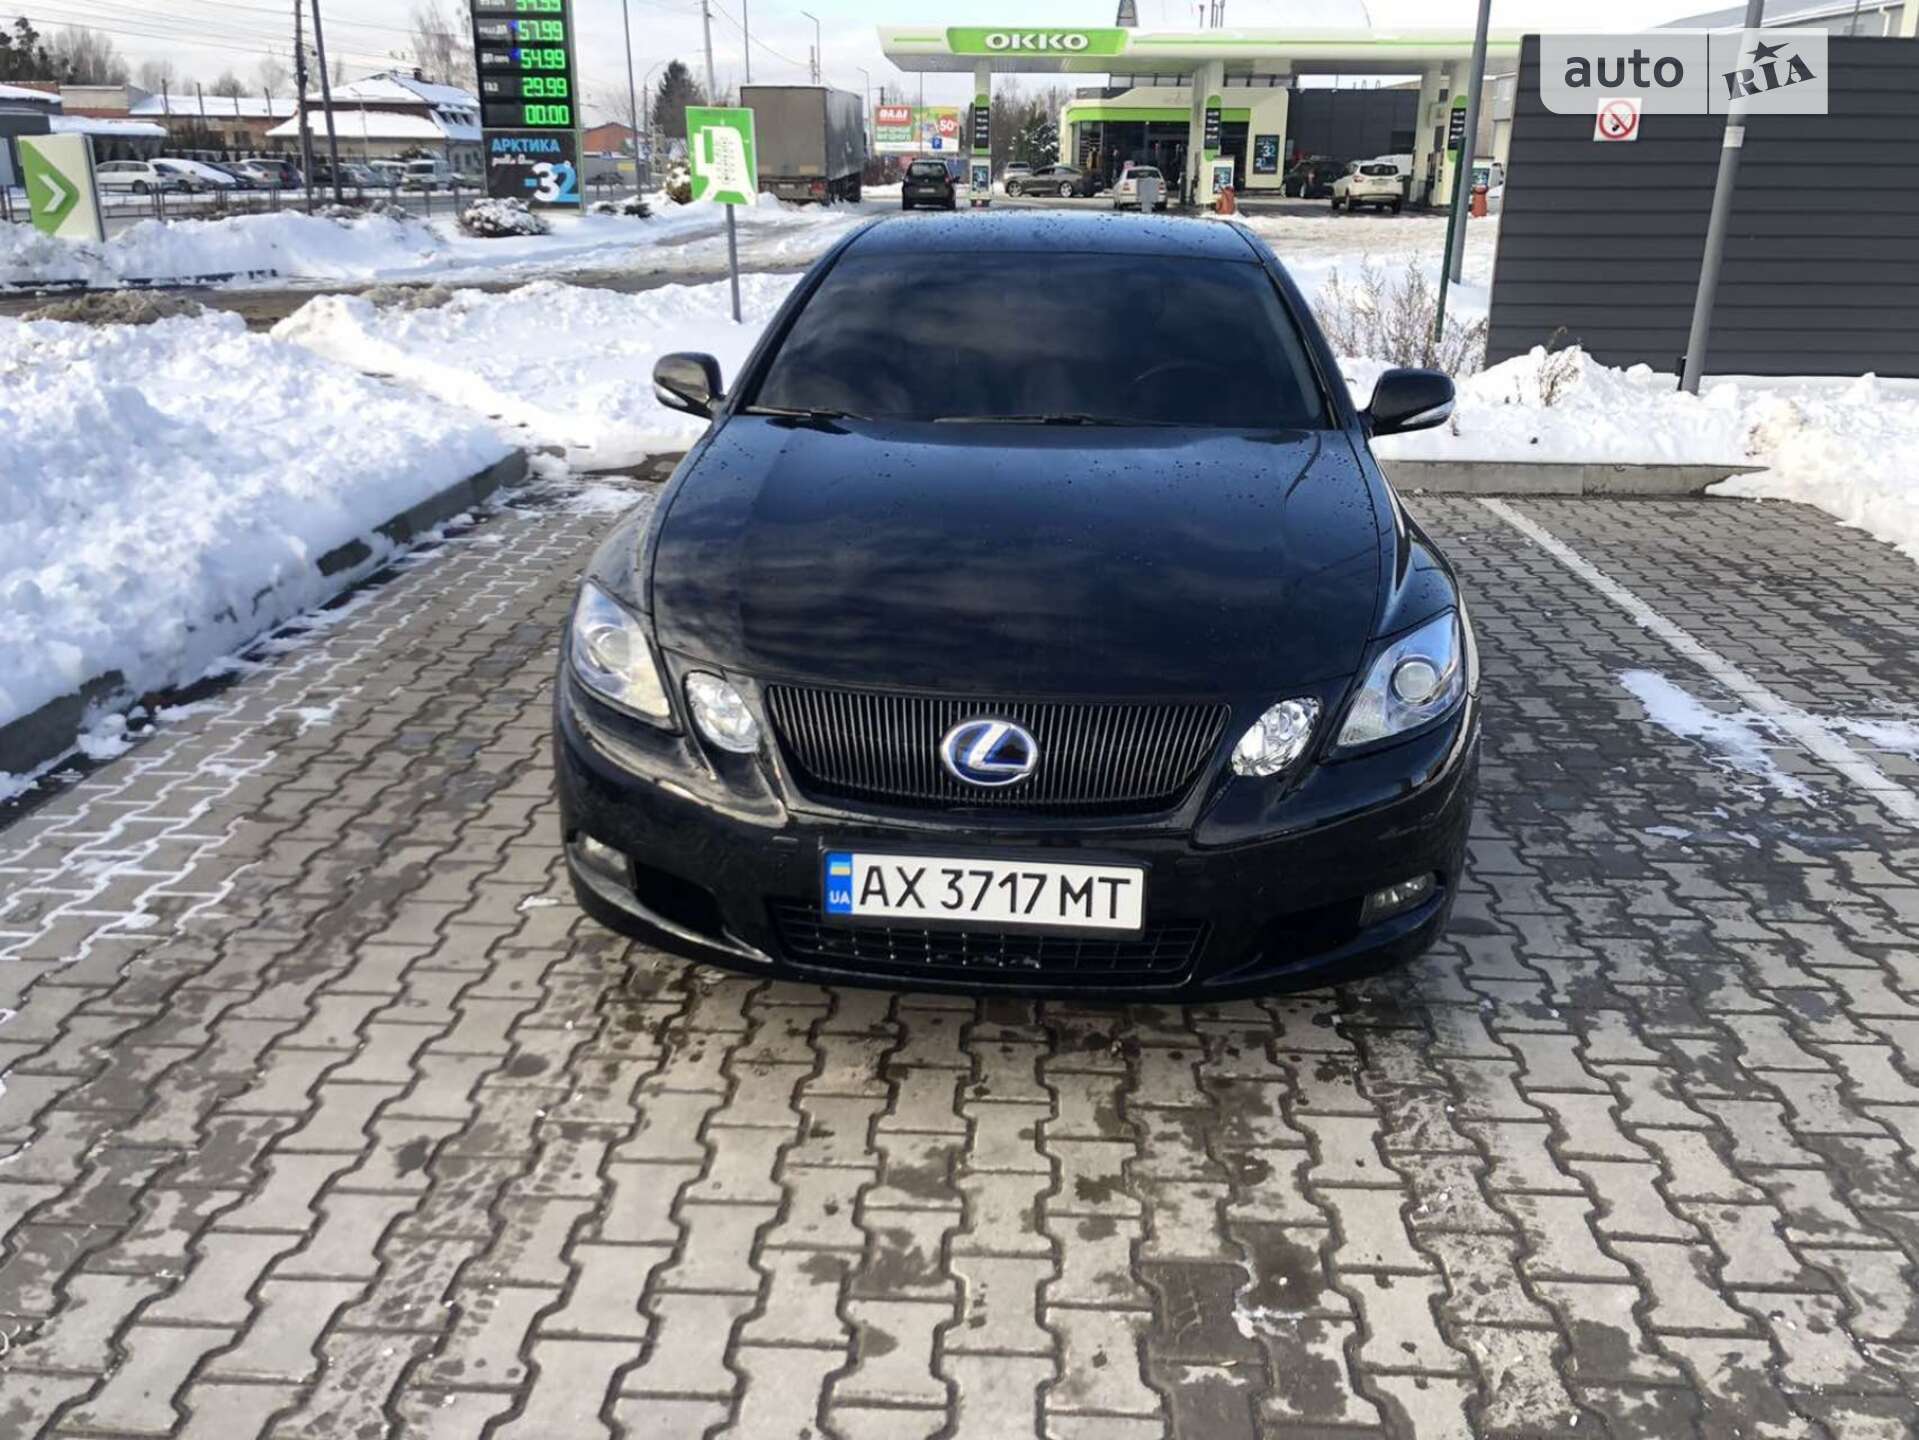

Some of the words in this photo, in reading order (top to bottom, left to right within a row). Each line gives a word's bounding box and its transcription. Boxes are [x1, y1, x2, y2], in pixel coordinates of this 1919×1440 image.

[519, 20, 564, 41] 57.99
[985, 33, 1088, 50] OKKO
[521, 49, 566, 69] 54.99
[522, 77, 567, 97] 29.99
[525, 105, 569, 125] 00.00
[491, 138, 560, 152] АРКТИКА
[829, 891, 850, 904] UA
[860, 865, 926, 909] AX
[940, 868, 1048, 914] 3717
[1059, 874, 1131, 919] MT
